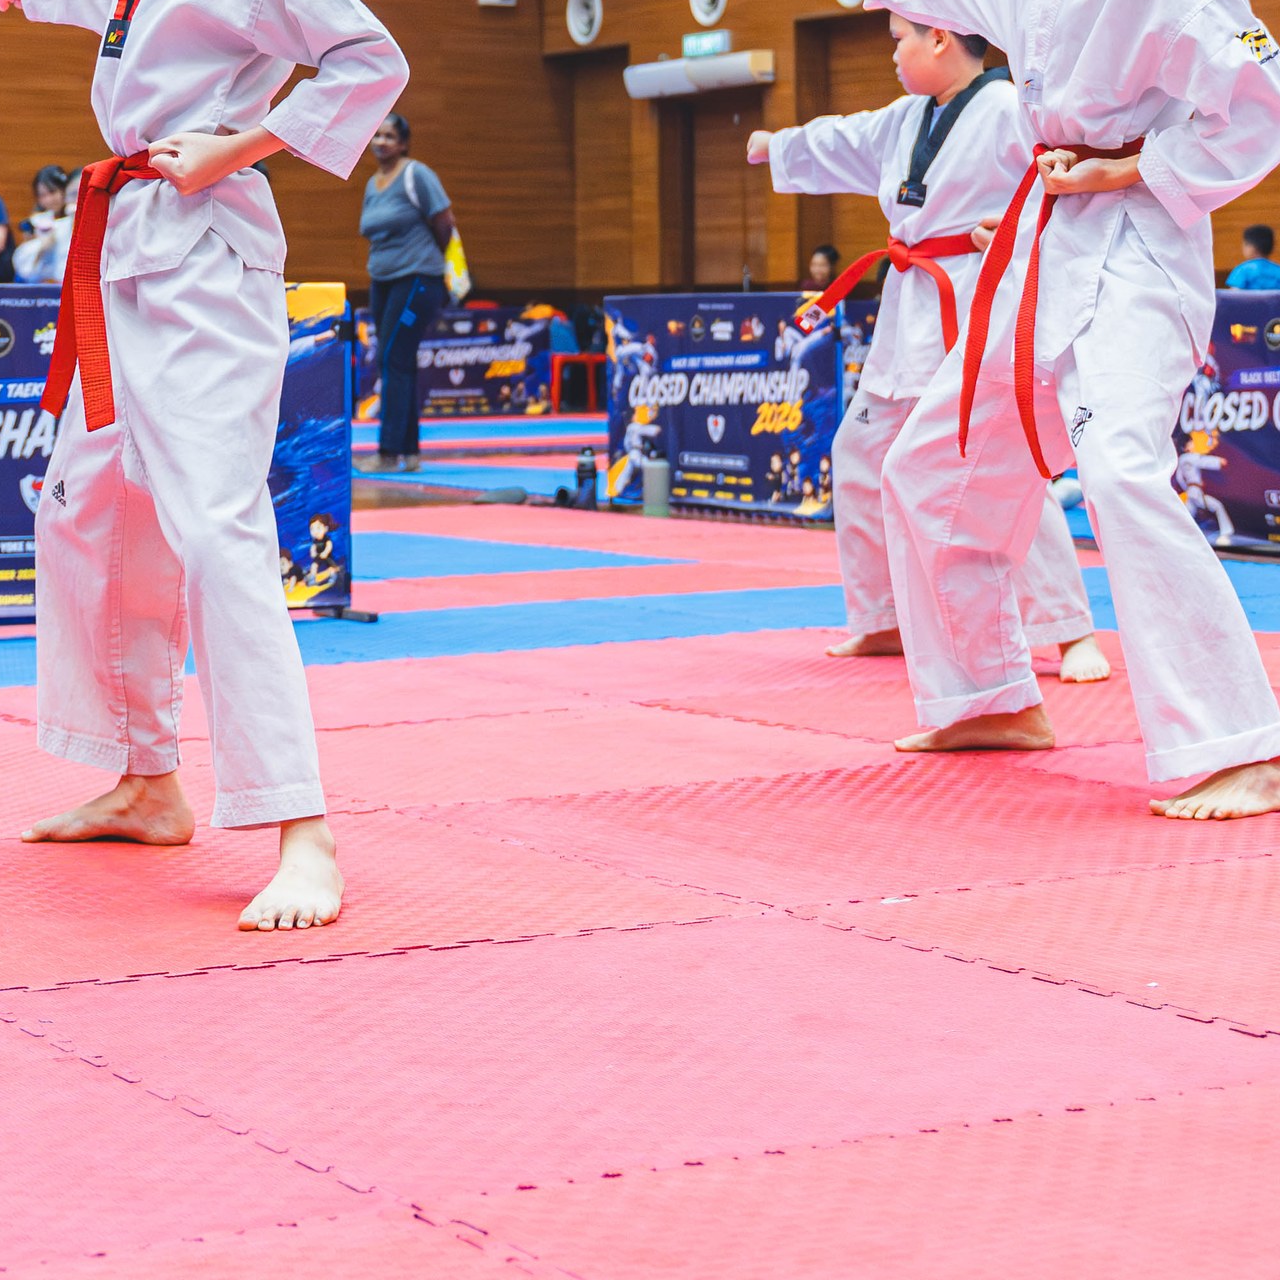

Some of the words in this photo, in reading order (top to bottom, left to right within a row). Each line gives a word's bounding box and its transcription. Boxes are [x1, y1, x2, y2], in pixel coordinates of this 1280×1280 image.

[628, 371, 689, 408] CLOSED
[689, 367, 811, 407] CHAMPIONSHIP
[750, 397, 804, 436] 2026
[1179, 390, 1270, 434] CLOSED
